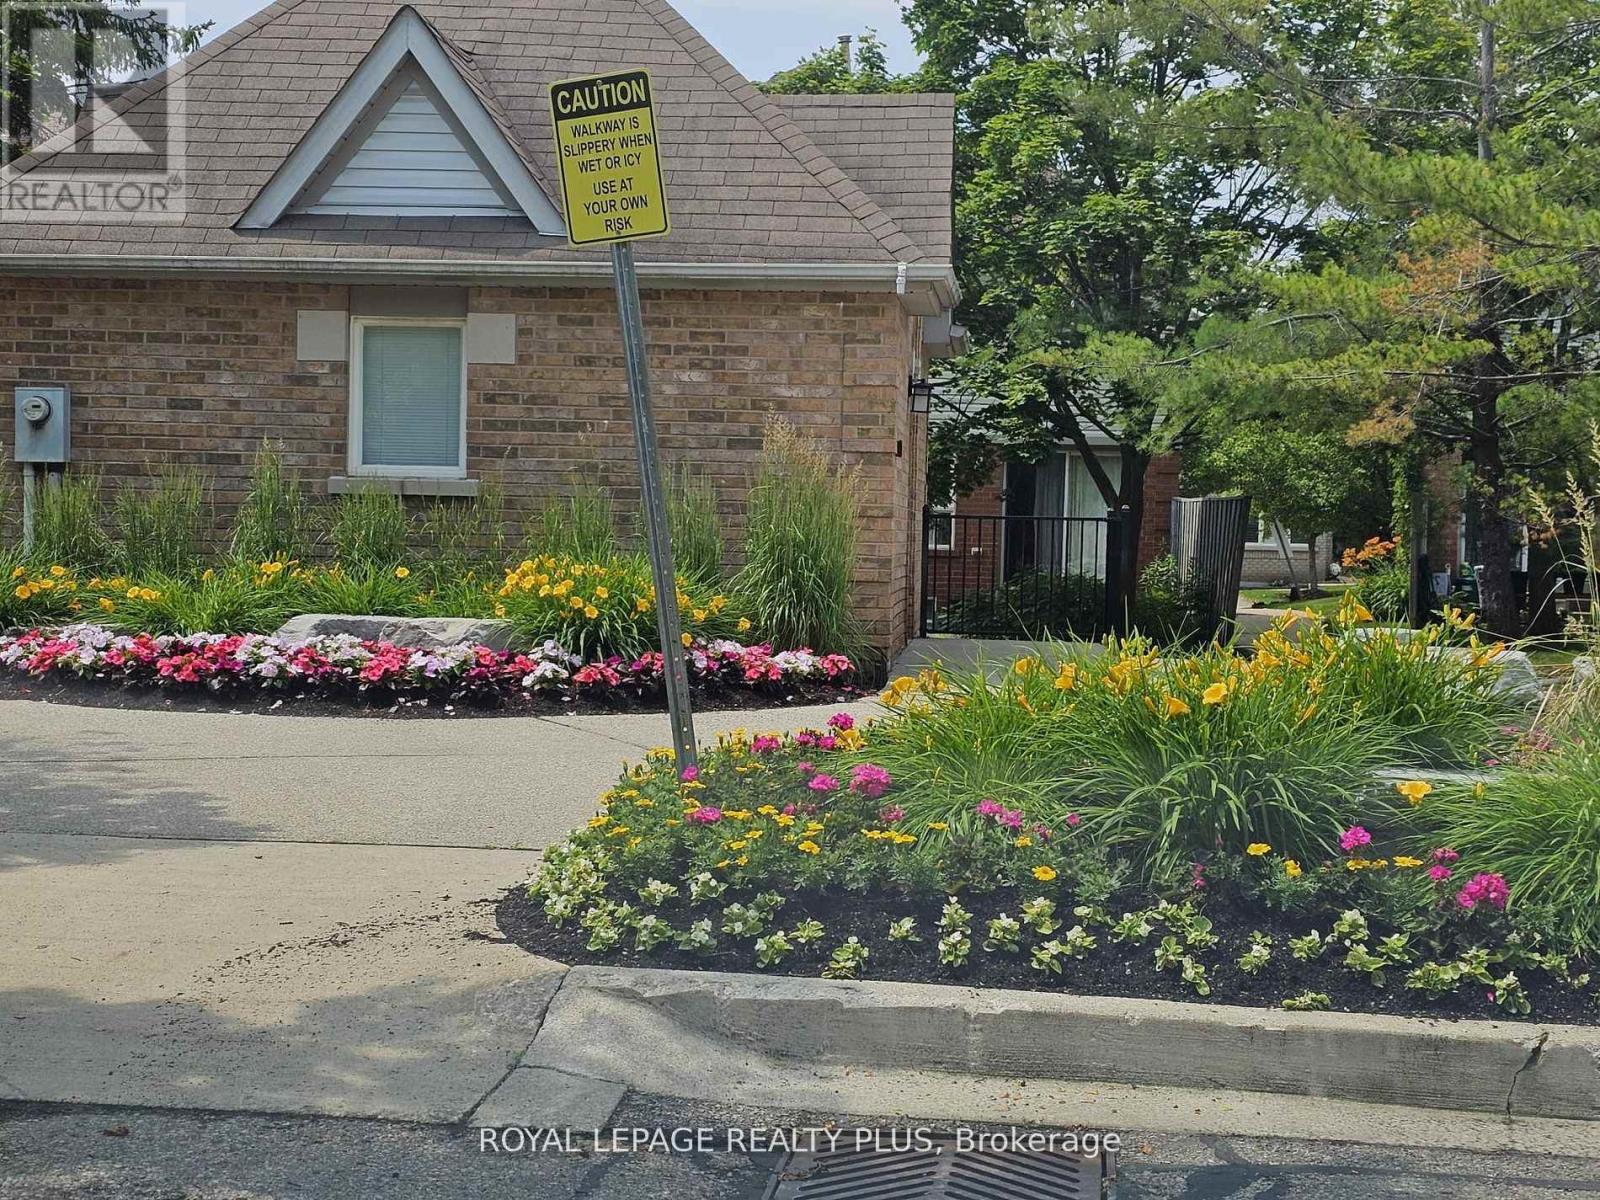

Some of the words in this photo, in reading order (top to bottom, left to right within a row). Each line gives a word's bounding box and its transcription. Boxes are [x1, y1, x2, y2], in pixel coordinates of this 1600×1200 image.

[557, 78, 646, 114] CAUTION
[570, 117, 626, 138] WALKWAY
[629, 116, 640, 129] IS
[563, 138, 617, 158] SLIPPERY
[618, 132, 652, 149] WHEN
[578, 158, 602, 174] WET
[605, 155, 621, 170] OR
[624, 152, 642, 167] ICY
[593, 181, 616, 196] USE
[620, 177, 634, 192] AT
[583, 201, 618, 216] YOUR
[620, 195, 648, 211] OWN
[605, 216, 633, 232] RISK
